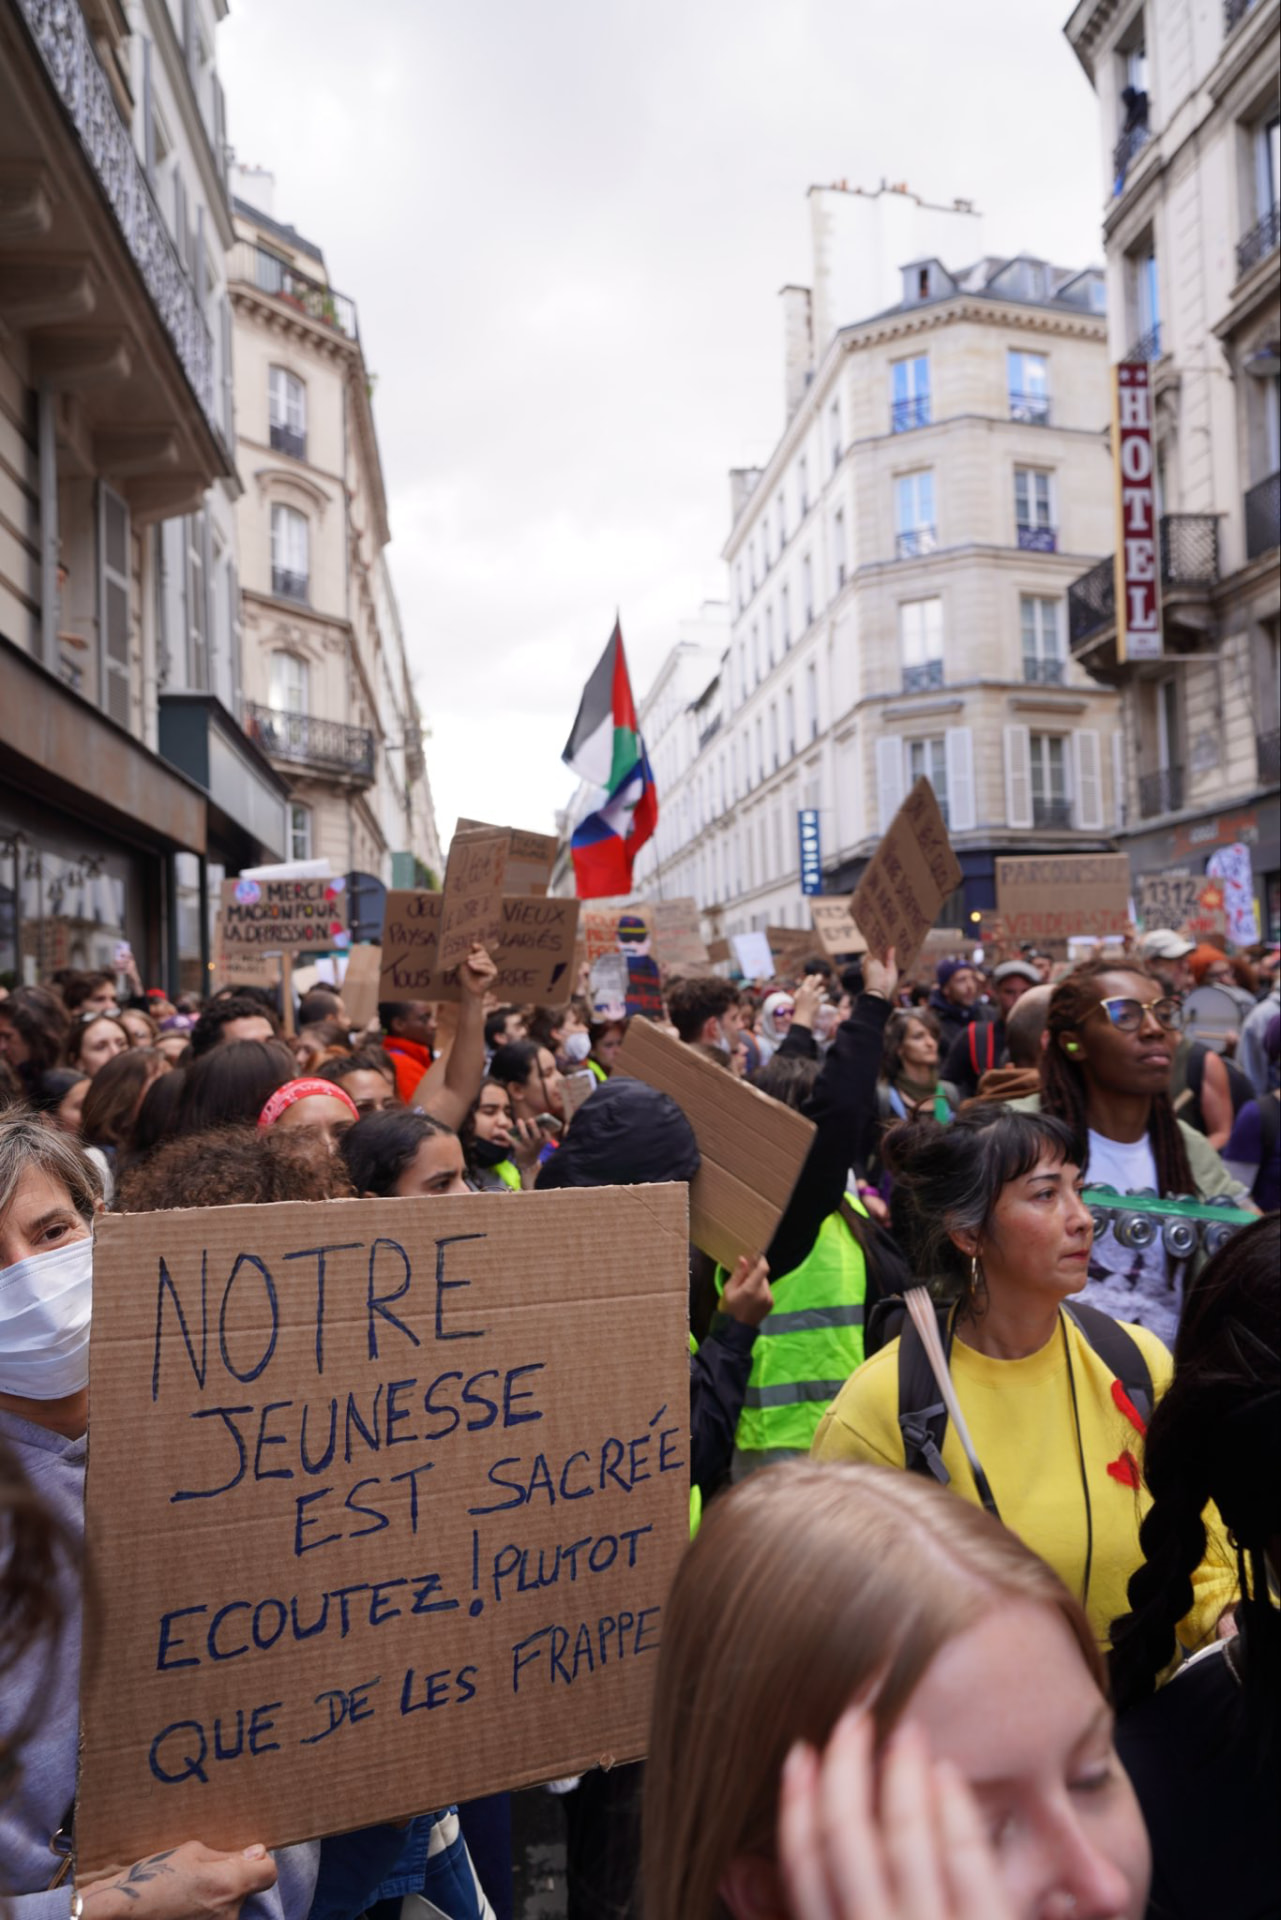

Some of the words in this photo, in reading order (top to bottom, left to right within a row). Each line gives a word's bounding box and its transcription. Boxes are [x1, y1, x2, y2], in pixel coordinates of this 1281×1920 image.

[1119, 386, 1157, 630] HOTEL
[226, 904, 292, 922] MACRON
[296, 901, 340, 920] POUR
[266, 882, 324, 902] MERCI
[406, 896, 441, 919] JEU
[1148, 880, 1197, 906] 1312
[223, 924, 242, 941] LA
[389, 922, 438, 946] PAYSA
[151, 1232, 489, 1402] NOTRE
[169, 1362, 547, 1503] JEUNESSE
[294, 1462, 436, 1557] EST
[467, 1404, 685, 1516] SACRÉE
[493, 1523, 654, 1602] PLUTOT
[148, 1701, 284, 1784] QUE
[300, 1675, 382, 1745] DE
[399, 1665, 478, 1717] LES
